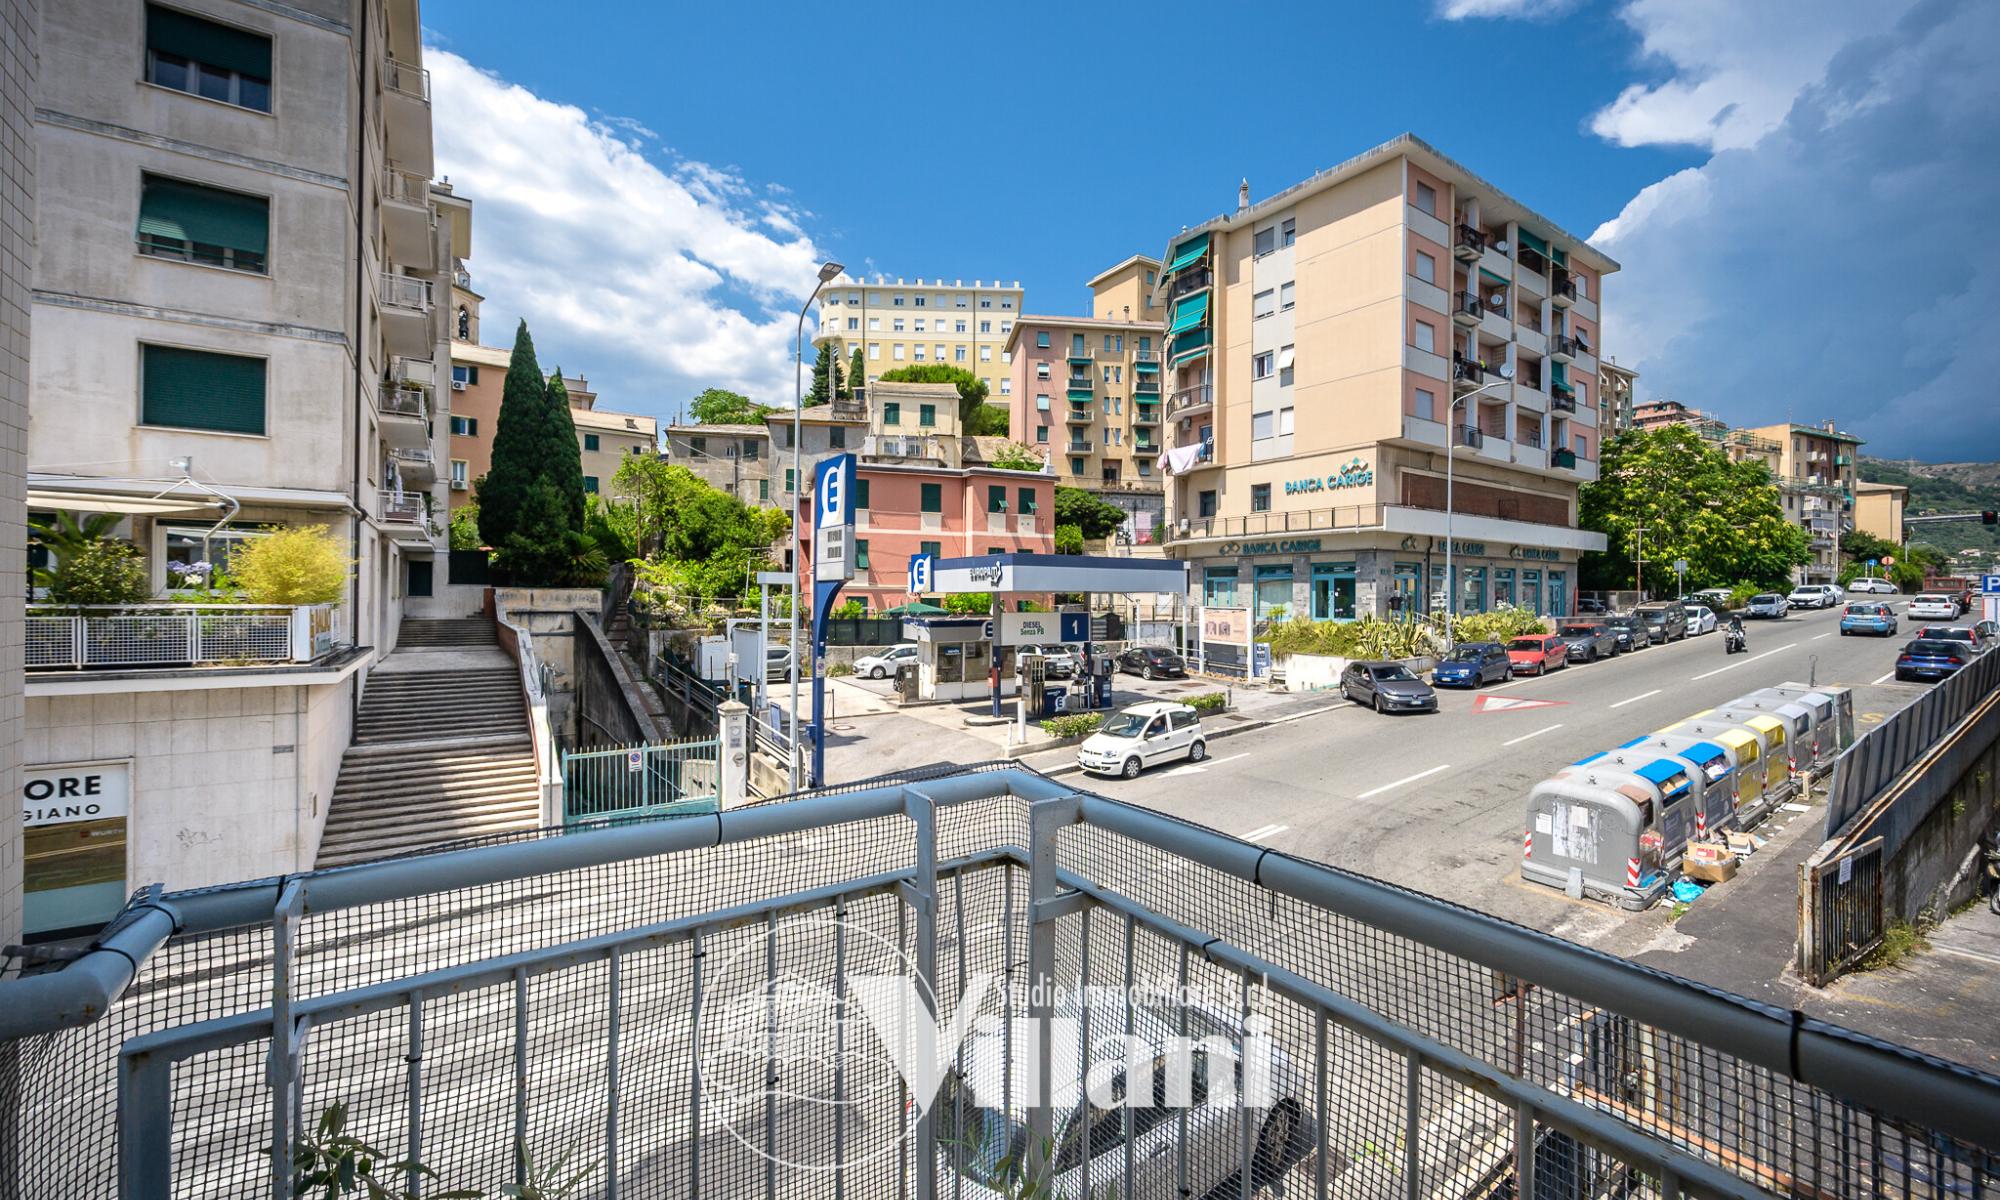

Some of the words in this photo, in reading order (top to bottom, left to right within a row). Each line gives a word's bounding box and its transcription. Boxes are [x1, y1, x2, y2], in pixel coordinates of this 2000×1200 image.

[1285, 477, 1324, 496] BANCA
[1326, 471, 1373, 490] CARIGE
[1242, 541, 1278, 555] BANCA
[1279, 538, 1321, 553] CARIGE
[1987, 577, 2000, 591] P
[1071, 619, 1079, 635] 1
